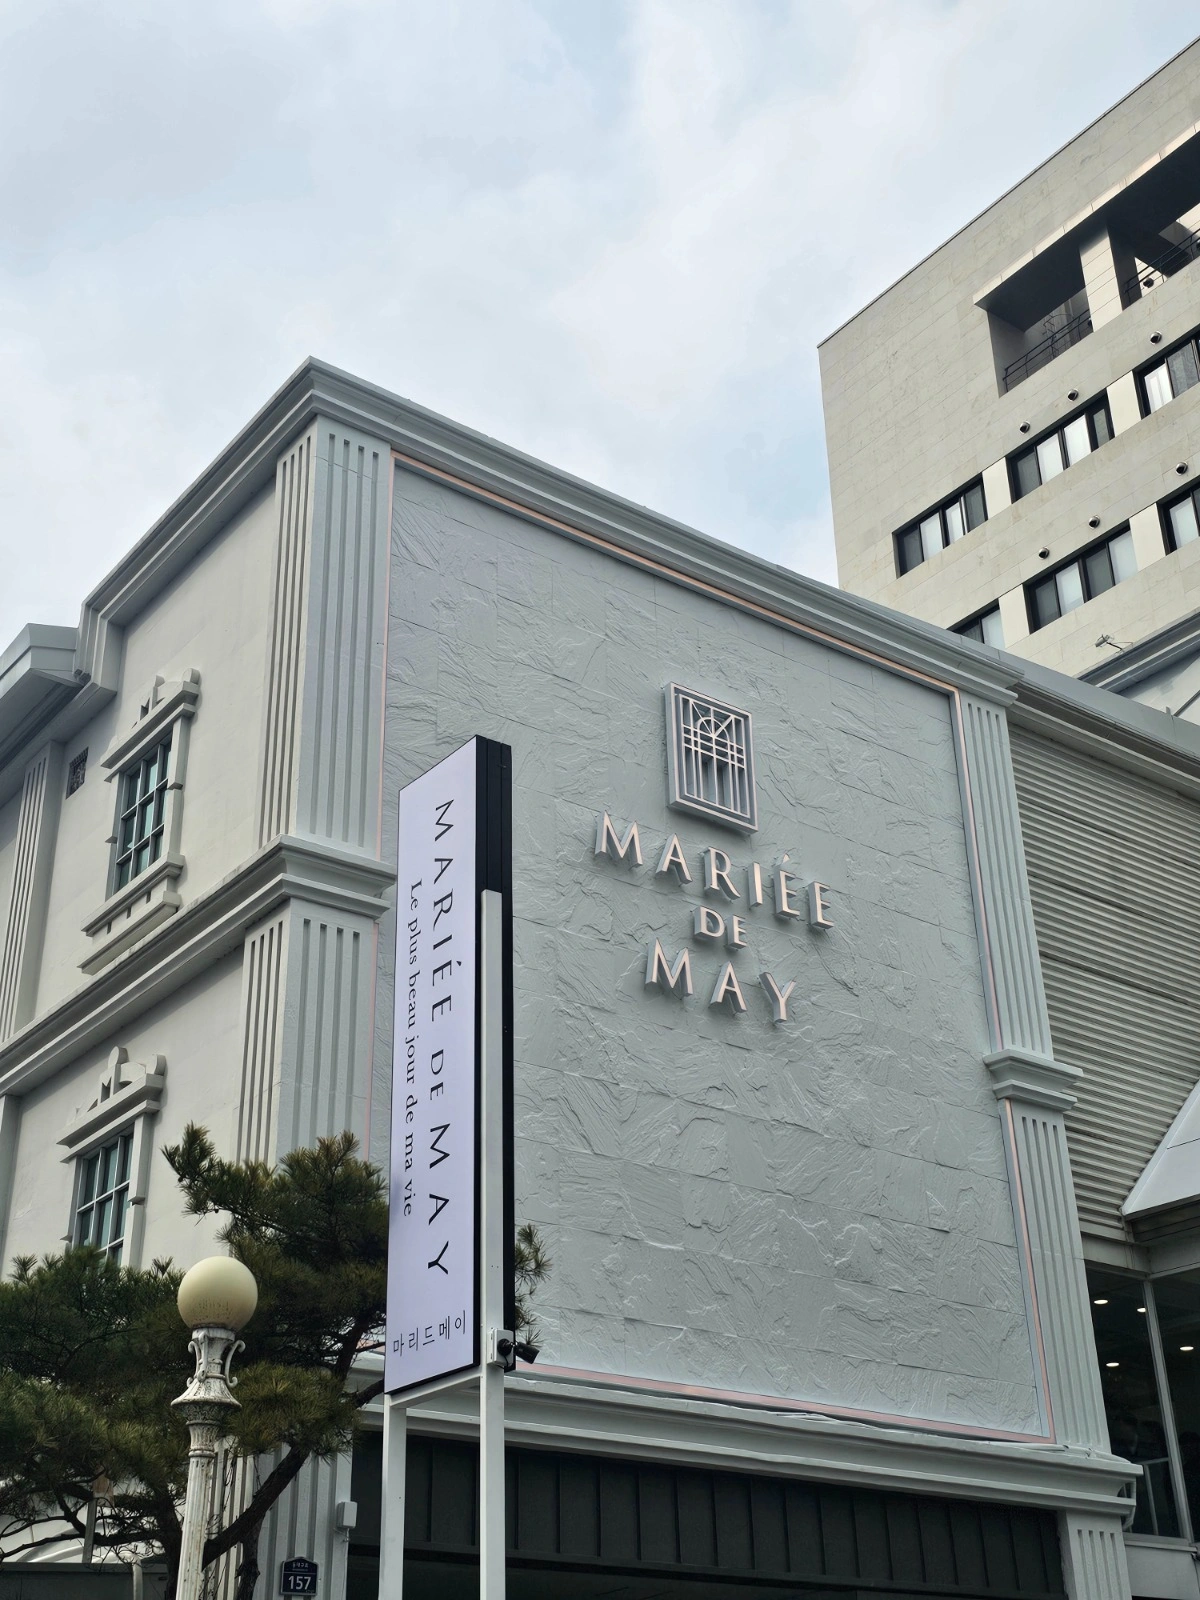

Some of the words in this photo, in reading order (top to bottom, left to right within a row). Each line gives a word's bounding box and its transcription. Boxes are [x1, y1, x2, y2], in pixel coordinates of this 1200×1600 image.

[595, 810, 834, 929] MARIÉE
[410, 878, 423, 911] Le
[431, 799, 462, 1022] MARIÉE
[407, 917, 422, 965] plus
[695, 905, 747, 949] DE
[407, 970, 421, 1029] beau
[646, 937, 796, 1023] MAY
[405, 1035, 419, 1084] jour
[430, 1049, 444, 1101] DE
[405, 1094, 418, 1124] de
[404, 1132, 414, 1172] ma
[403, 1178, 416, 1217] vie
[427, 1123, 451, 1275] MAY
[393, 1309, 466, 1357] 마리드메이
[288, 1575, 312, 1590] 157
